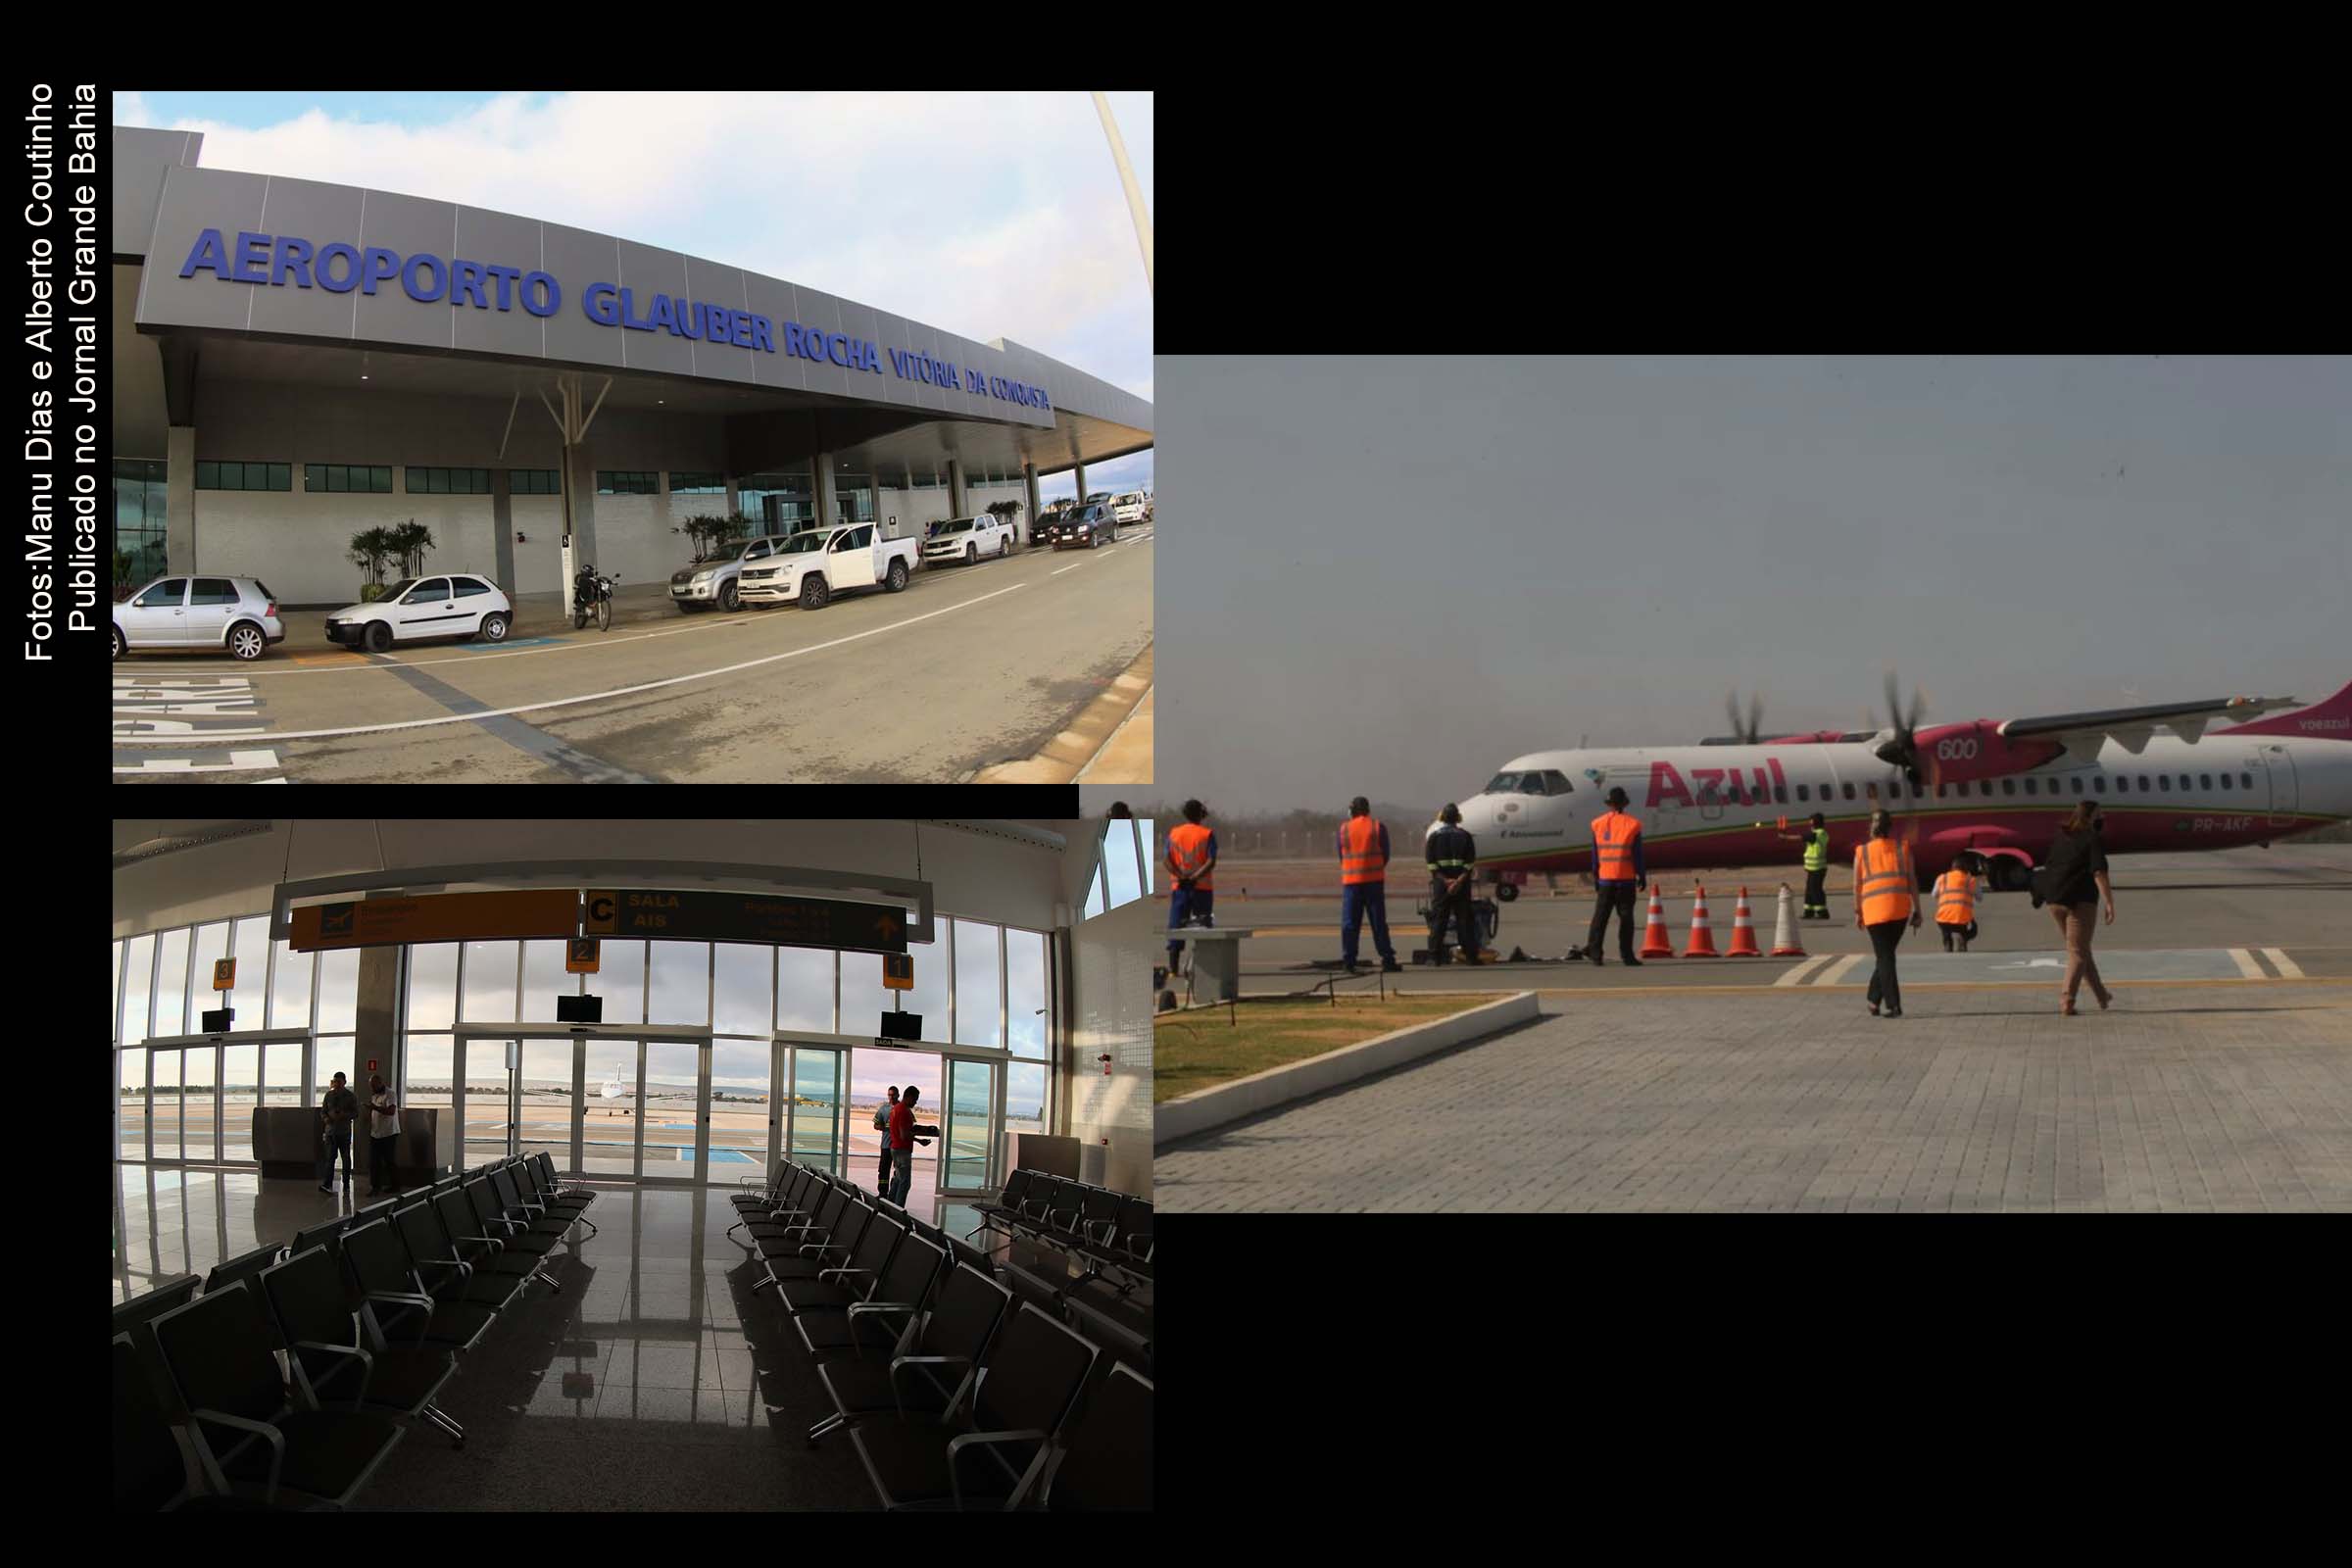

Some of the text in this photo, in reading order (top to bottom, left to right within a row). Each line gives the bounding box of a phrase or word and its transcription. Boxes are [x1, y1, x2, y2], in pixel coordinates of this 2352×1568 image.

[178, 228, 1052, 411] AEROPORTO GLAUBER ROCHA VITÓRIA DA CONQUISTA
[1937, 738, 1978, 760] 600
[1645, 758, 1789, 808] Azul
[591, 898, 615, 922] C
[627, 893, 680, 909] SALA
[576, 941, 589, 960] 2
